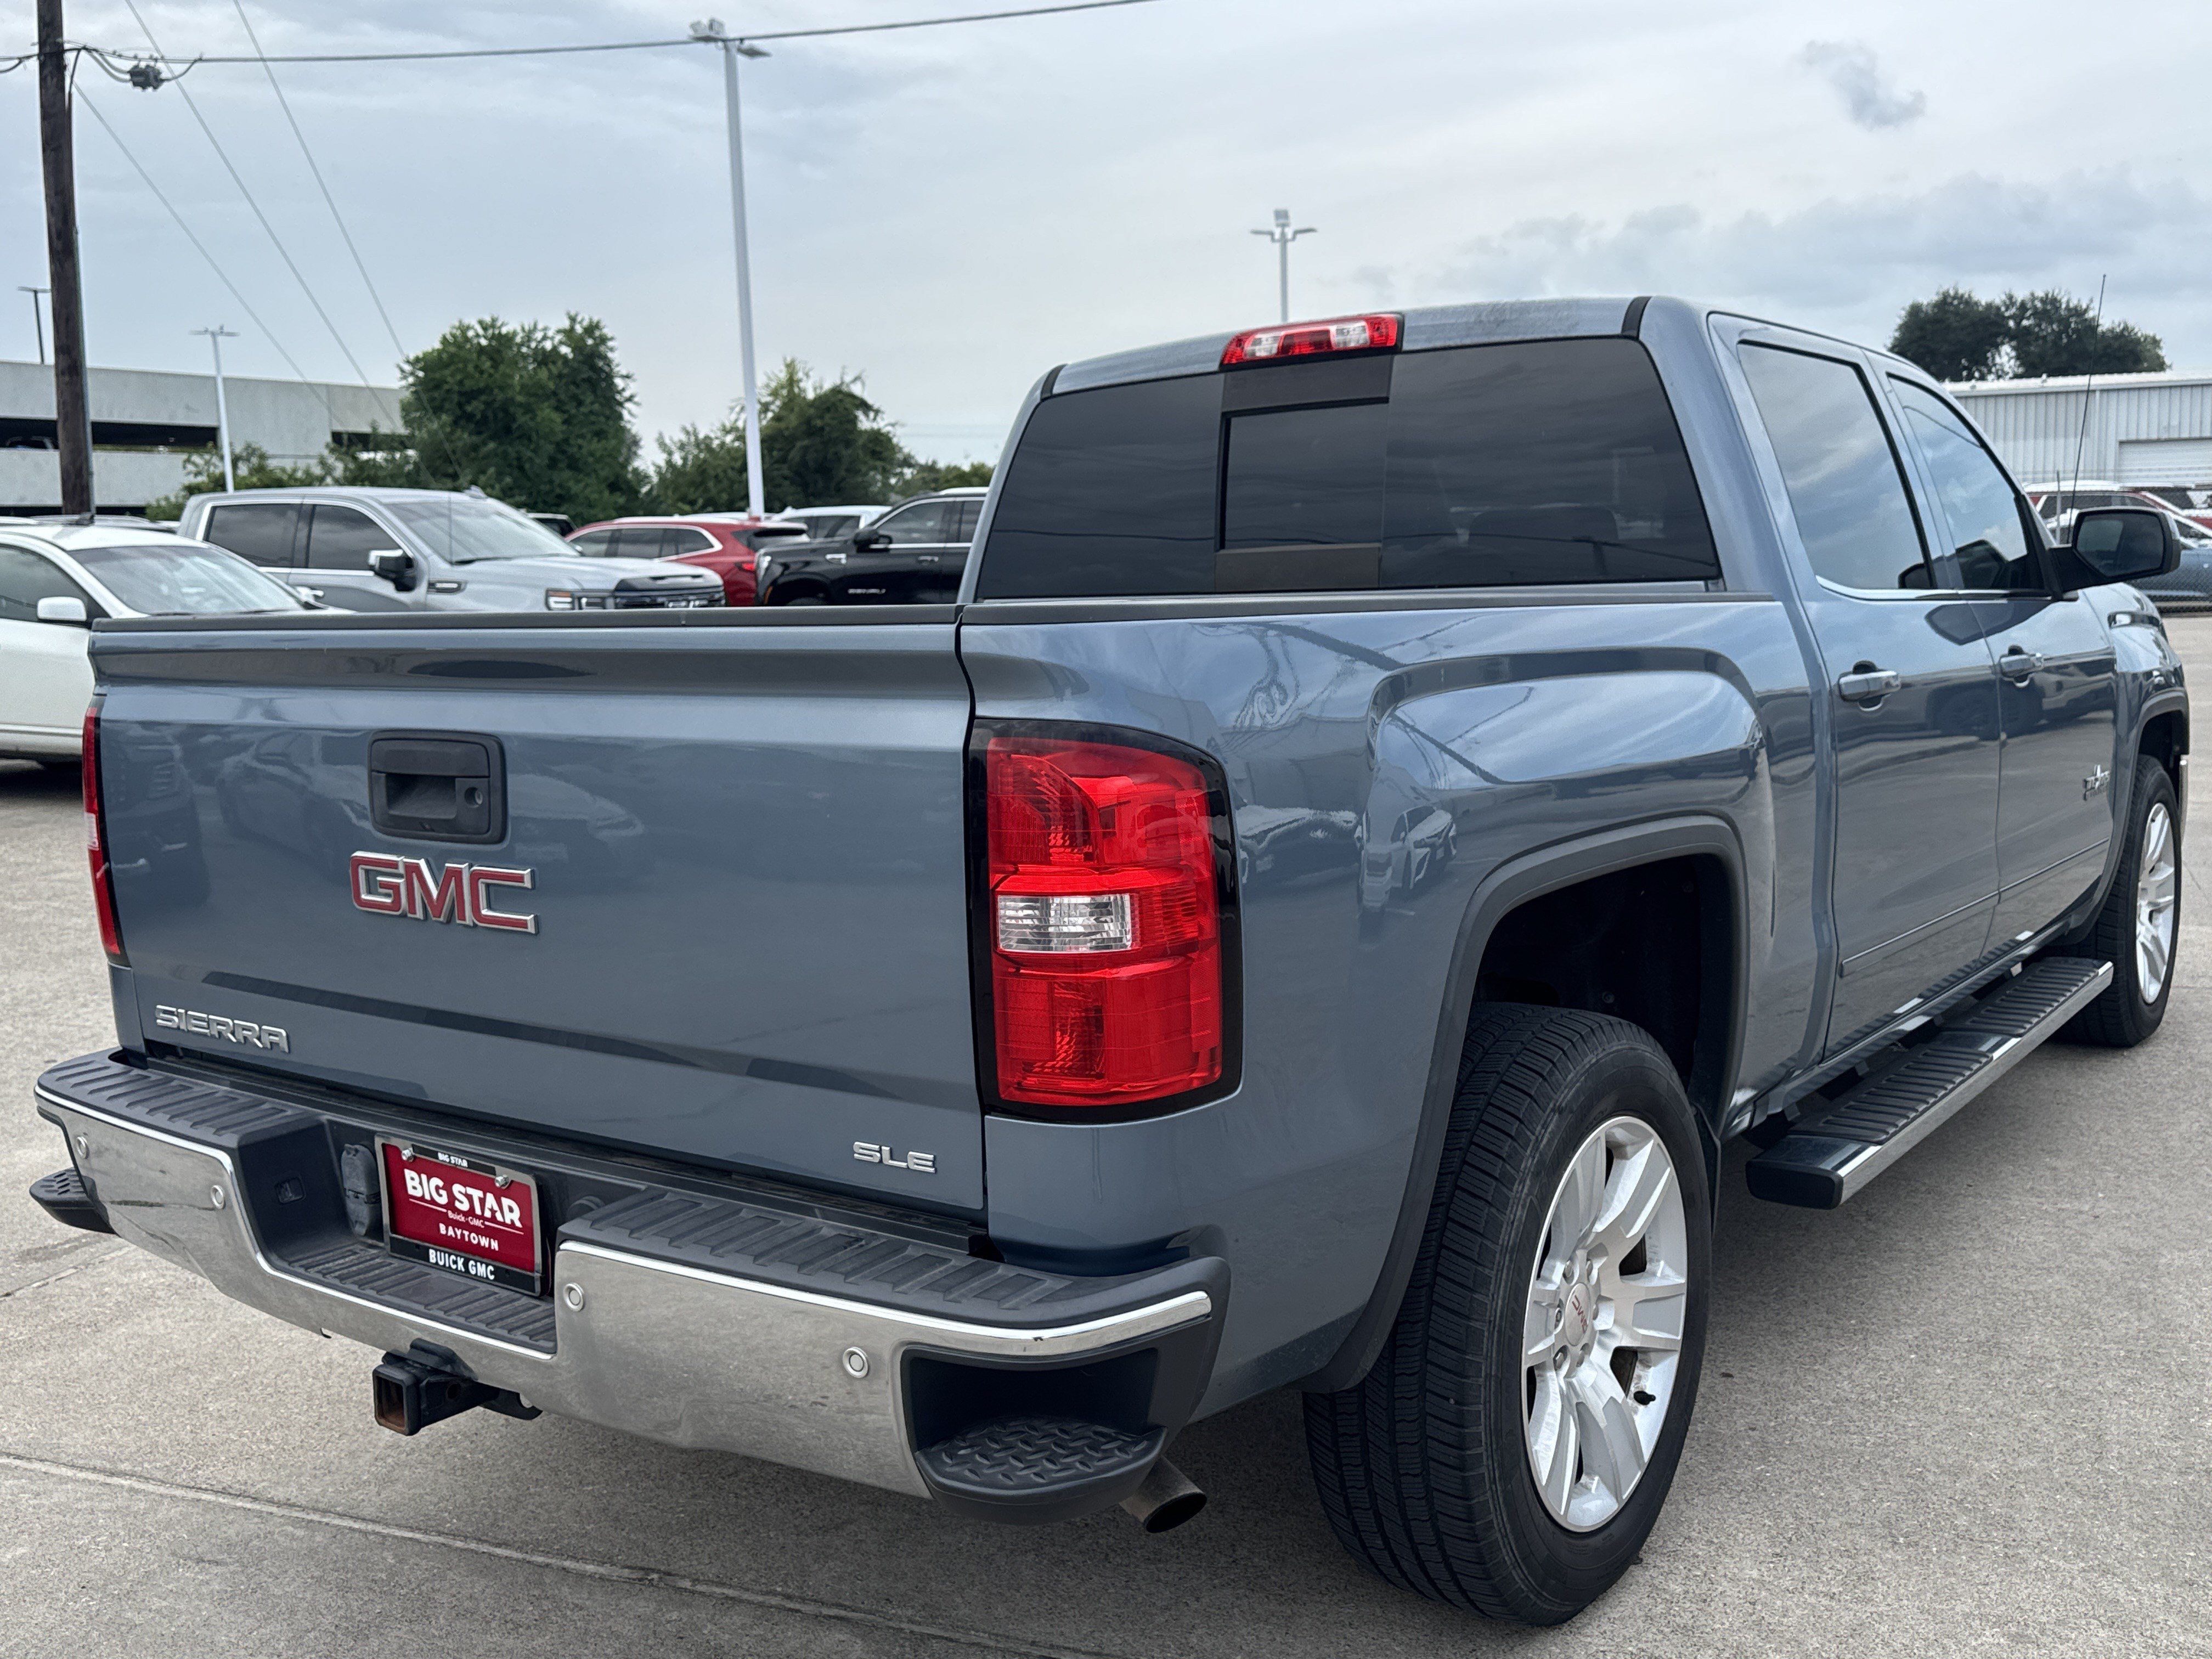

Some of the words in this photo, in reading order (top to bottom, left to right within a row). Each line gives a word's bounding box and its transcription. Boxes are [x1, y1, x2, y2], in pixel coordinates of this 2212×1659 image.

[349, 851, 539, 934] GMC
[155, 1005, 290, 1053] SIERRA
[450, 1156, 468, 1167] STAR
[853, 1141, 936, 1173] SLE
[404, 1169, 448, 1205] BIG
[452, 1183, 523, 1228] STAR
[439, 1223, 499, 1251] BAYTOWN
[428, 1249, 465, 1272] BUICK
[469, 1260, 495, 1280] GMC
